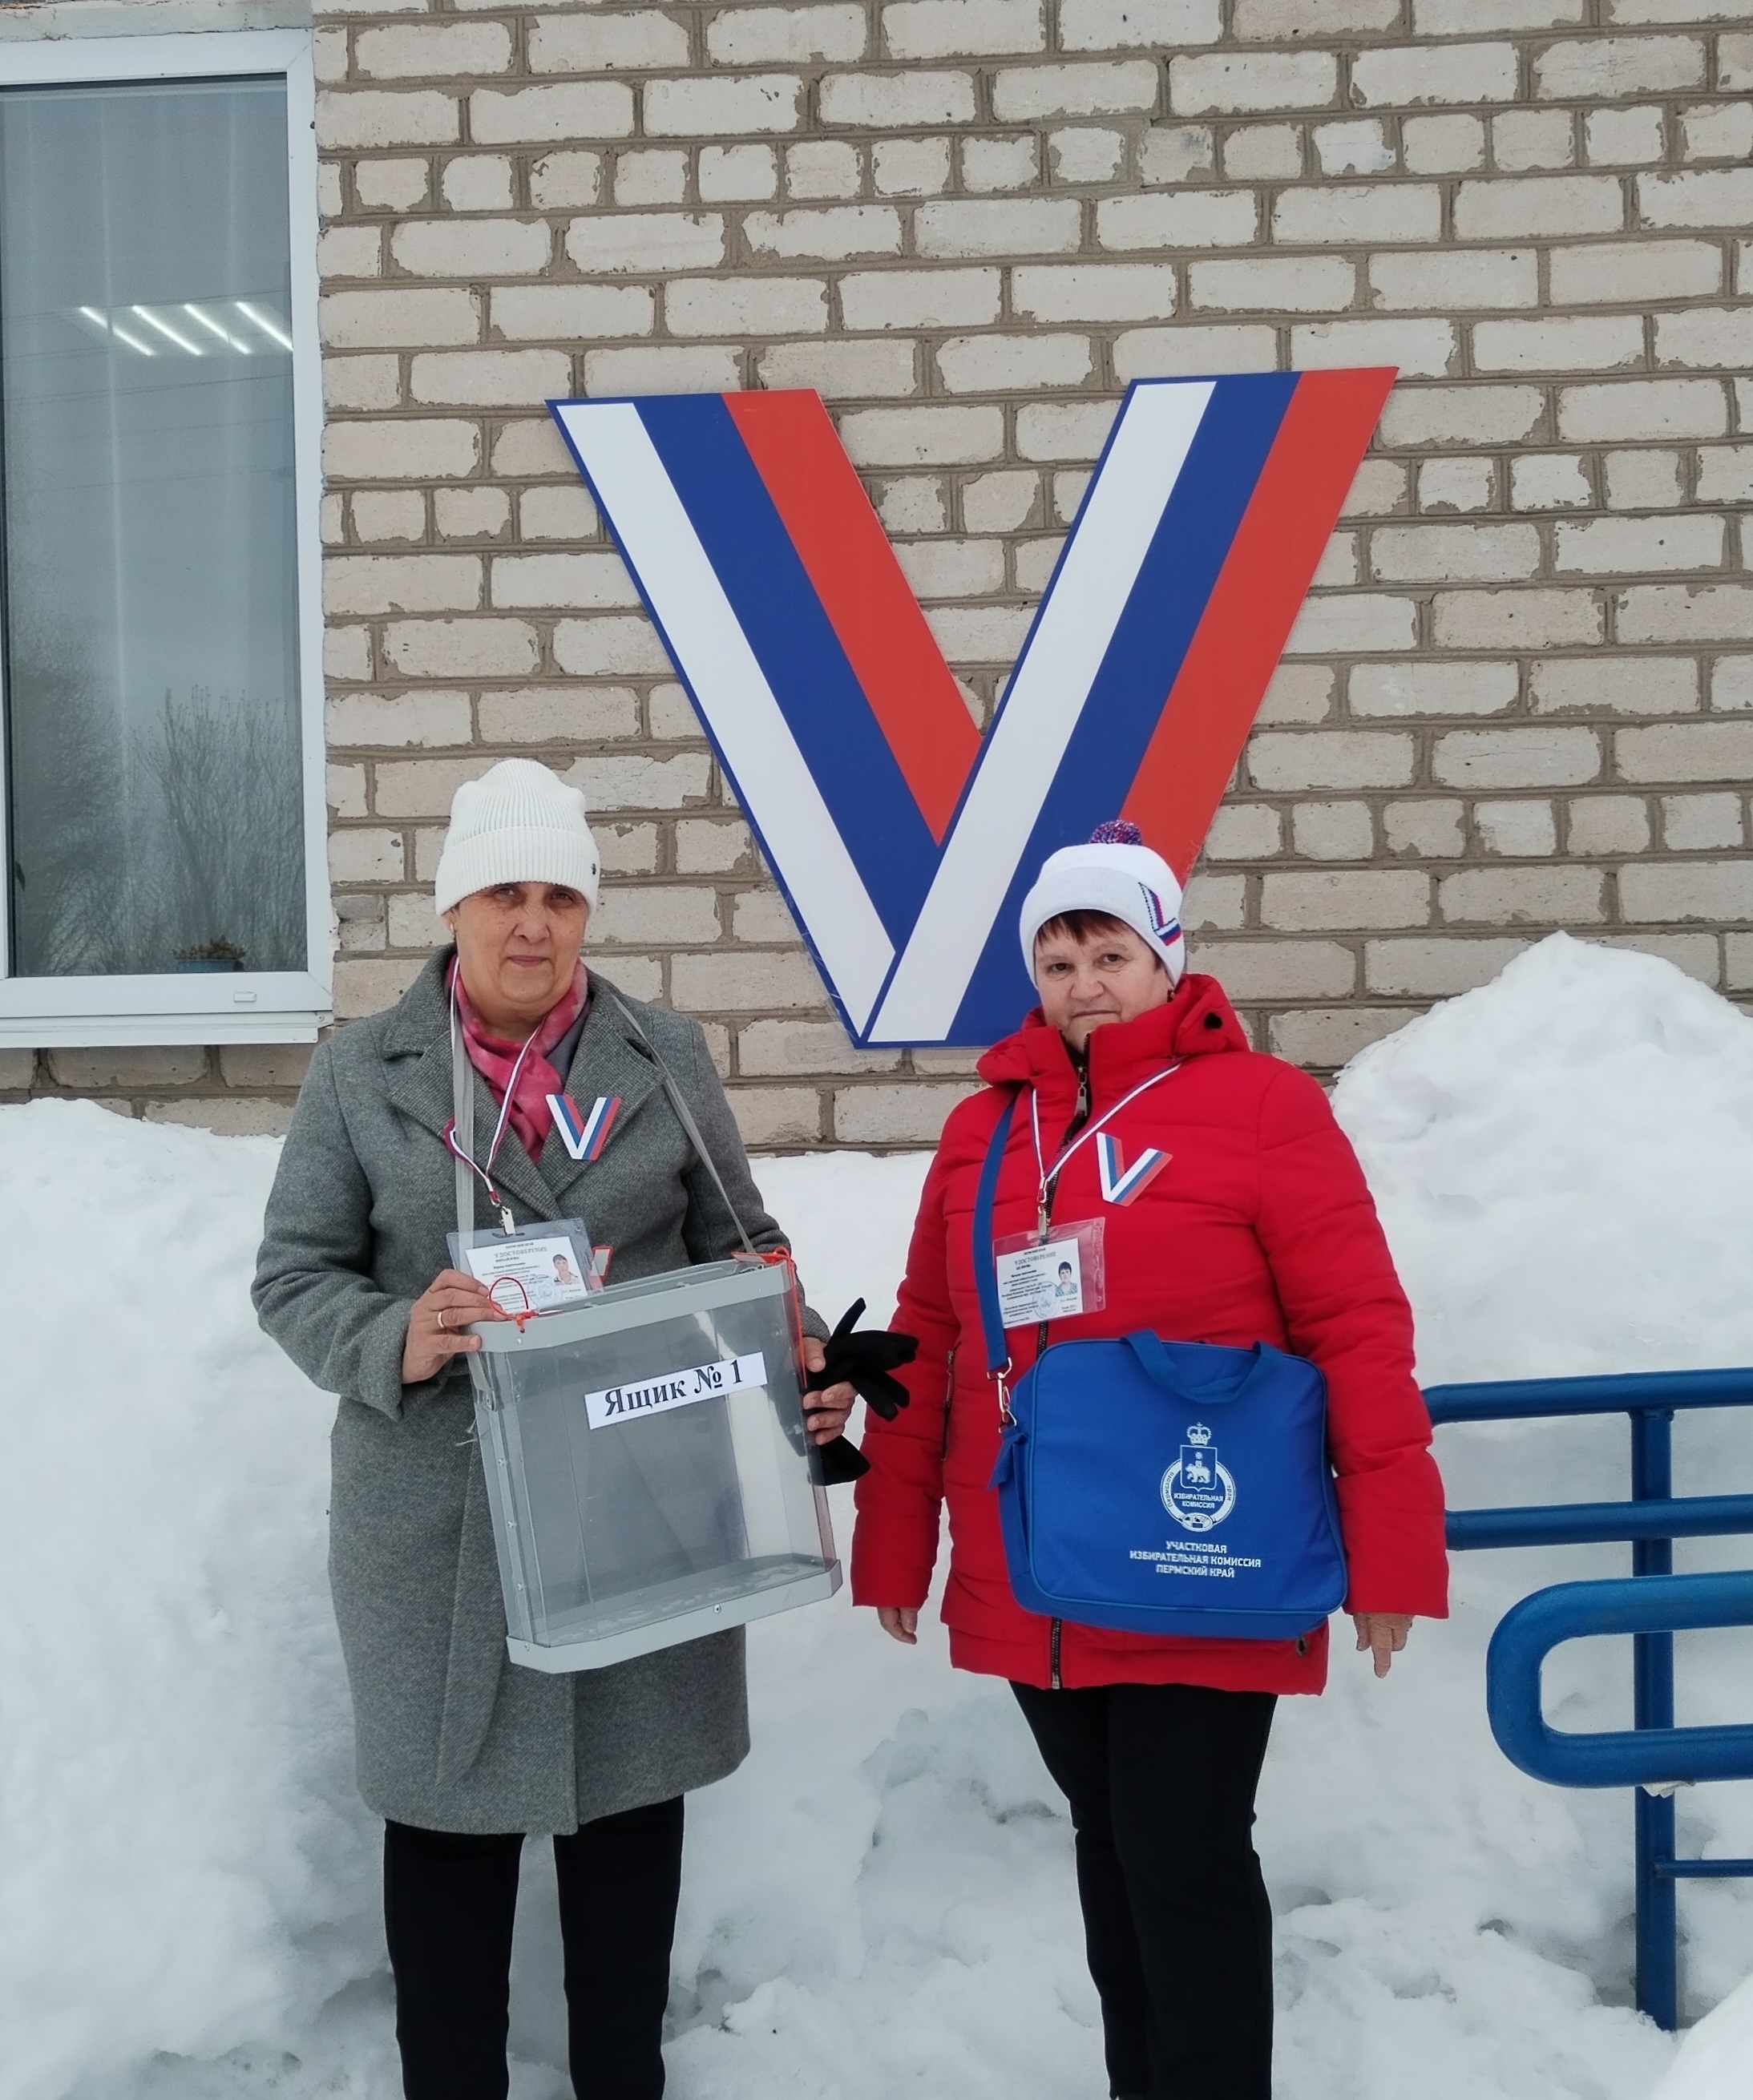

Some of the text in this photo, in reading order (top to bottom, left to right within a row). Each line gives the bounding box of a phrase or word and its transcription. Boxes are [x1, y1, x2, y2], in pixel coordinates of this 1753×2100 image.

[494, 1246, 548, 1258] УДОСТОВЕРЕНИЕ
[1014, 1251, 1056, 1266] УДОСТОВЕРЕНИЕ
[604, 1359, 744, 1417] Ящик № 1
[1173, 1492, 1224, 1502] ИЗБИРАТЕЛЬНАЯ
[1181, 1500, 1215, 1508] КОМИССИЯ
[1165, 1540, 1227, 1553] УЧАСТКОВАЯ
[1129, 1549, 1261, 1568] ИЗБИРАТЕЛЬНАЯ КОМИССИЯ
[1156, 1564, 1235, 1578] ПЕРМСКИЙ КРАЙ
